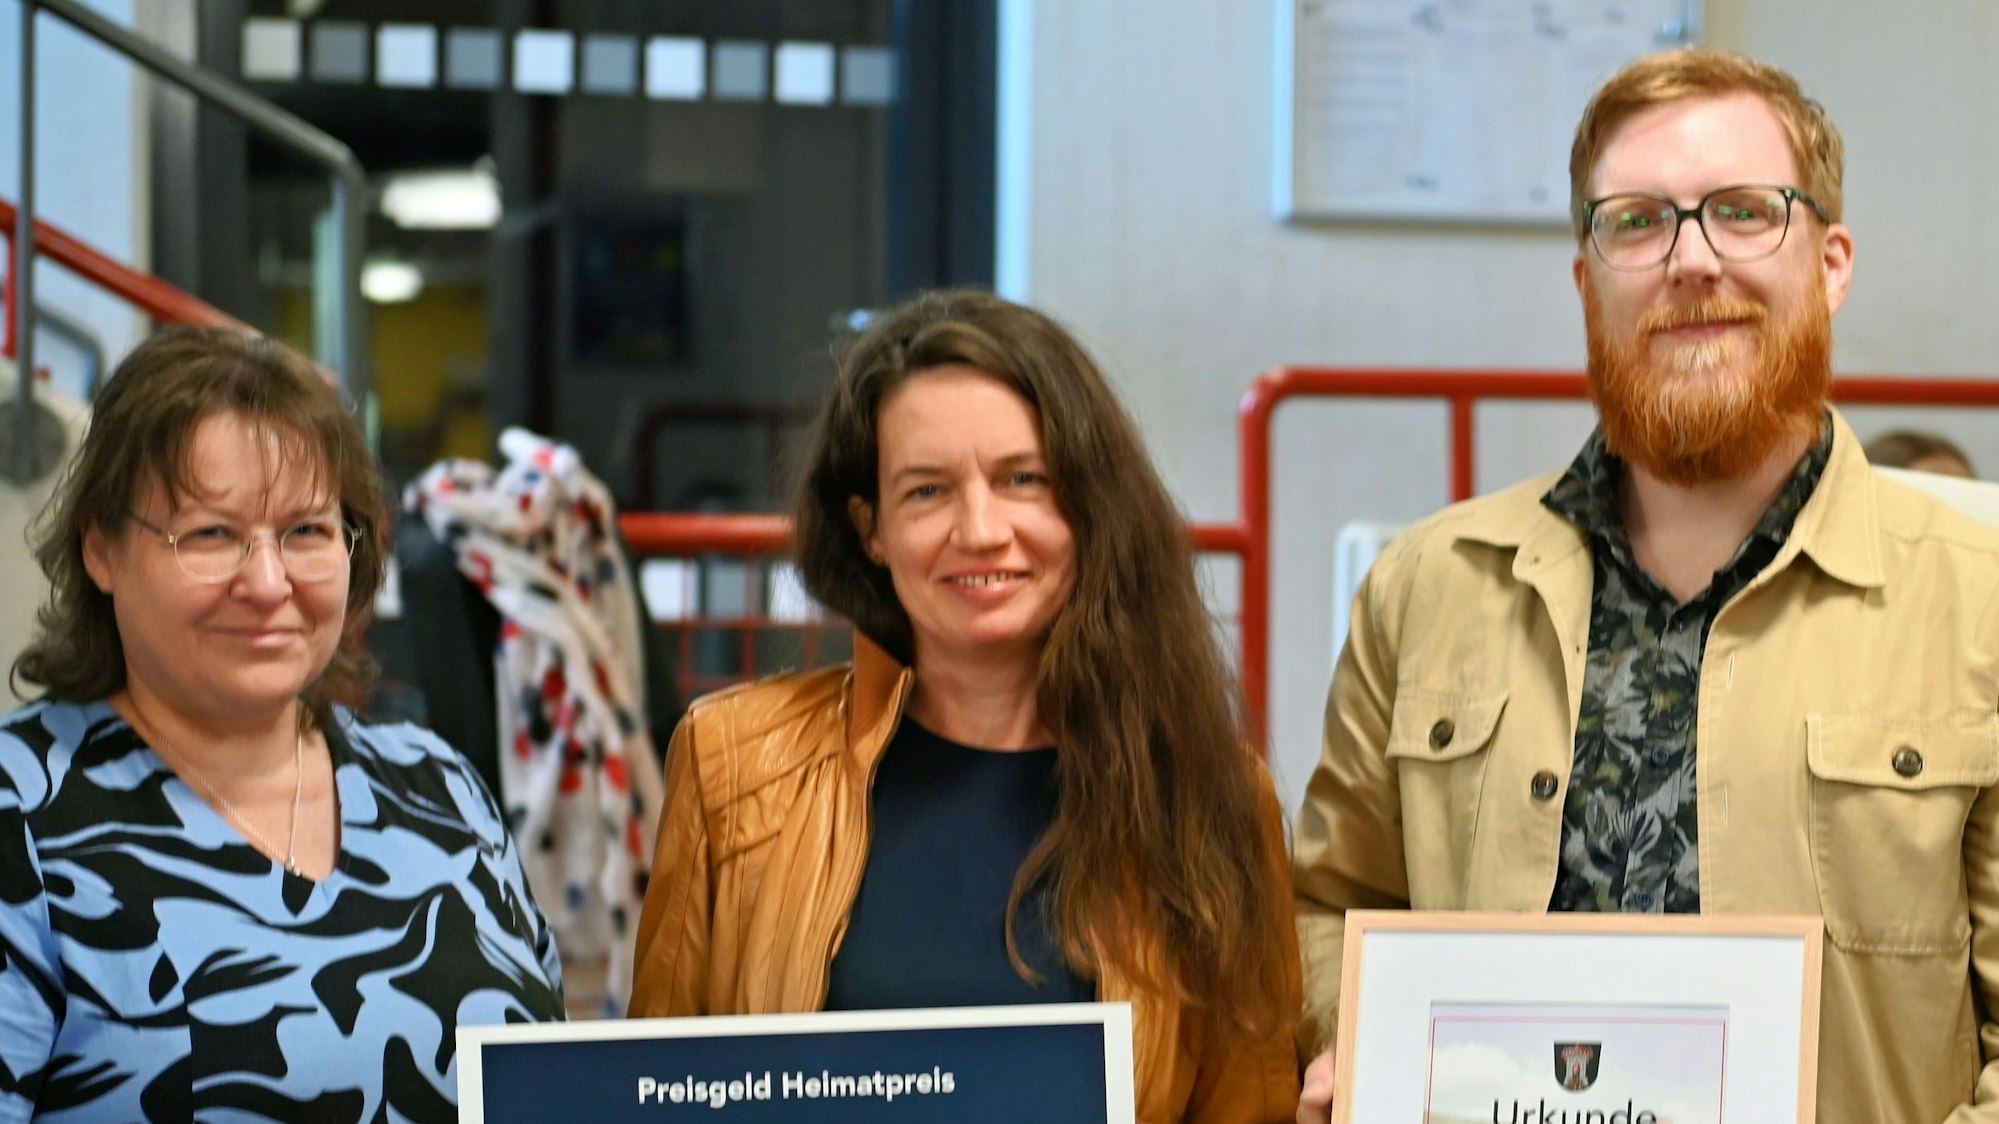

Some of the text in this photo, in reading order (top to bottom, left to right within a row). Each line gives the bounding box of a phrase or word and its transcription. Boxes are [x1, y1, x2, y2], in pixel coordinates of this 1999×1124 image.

[638, 1066, 956, 1109] Preisgeld Heimatpreis
[1492, 1097, 1658, 1124] Urkunde
